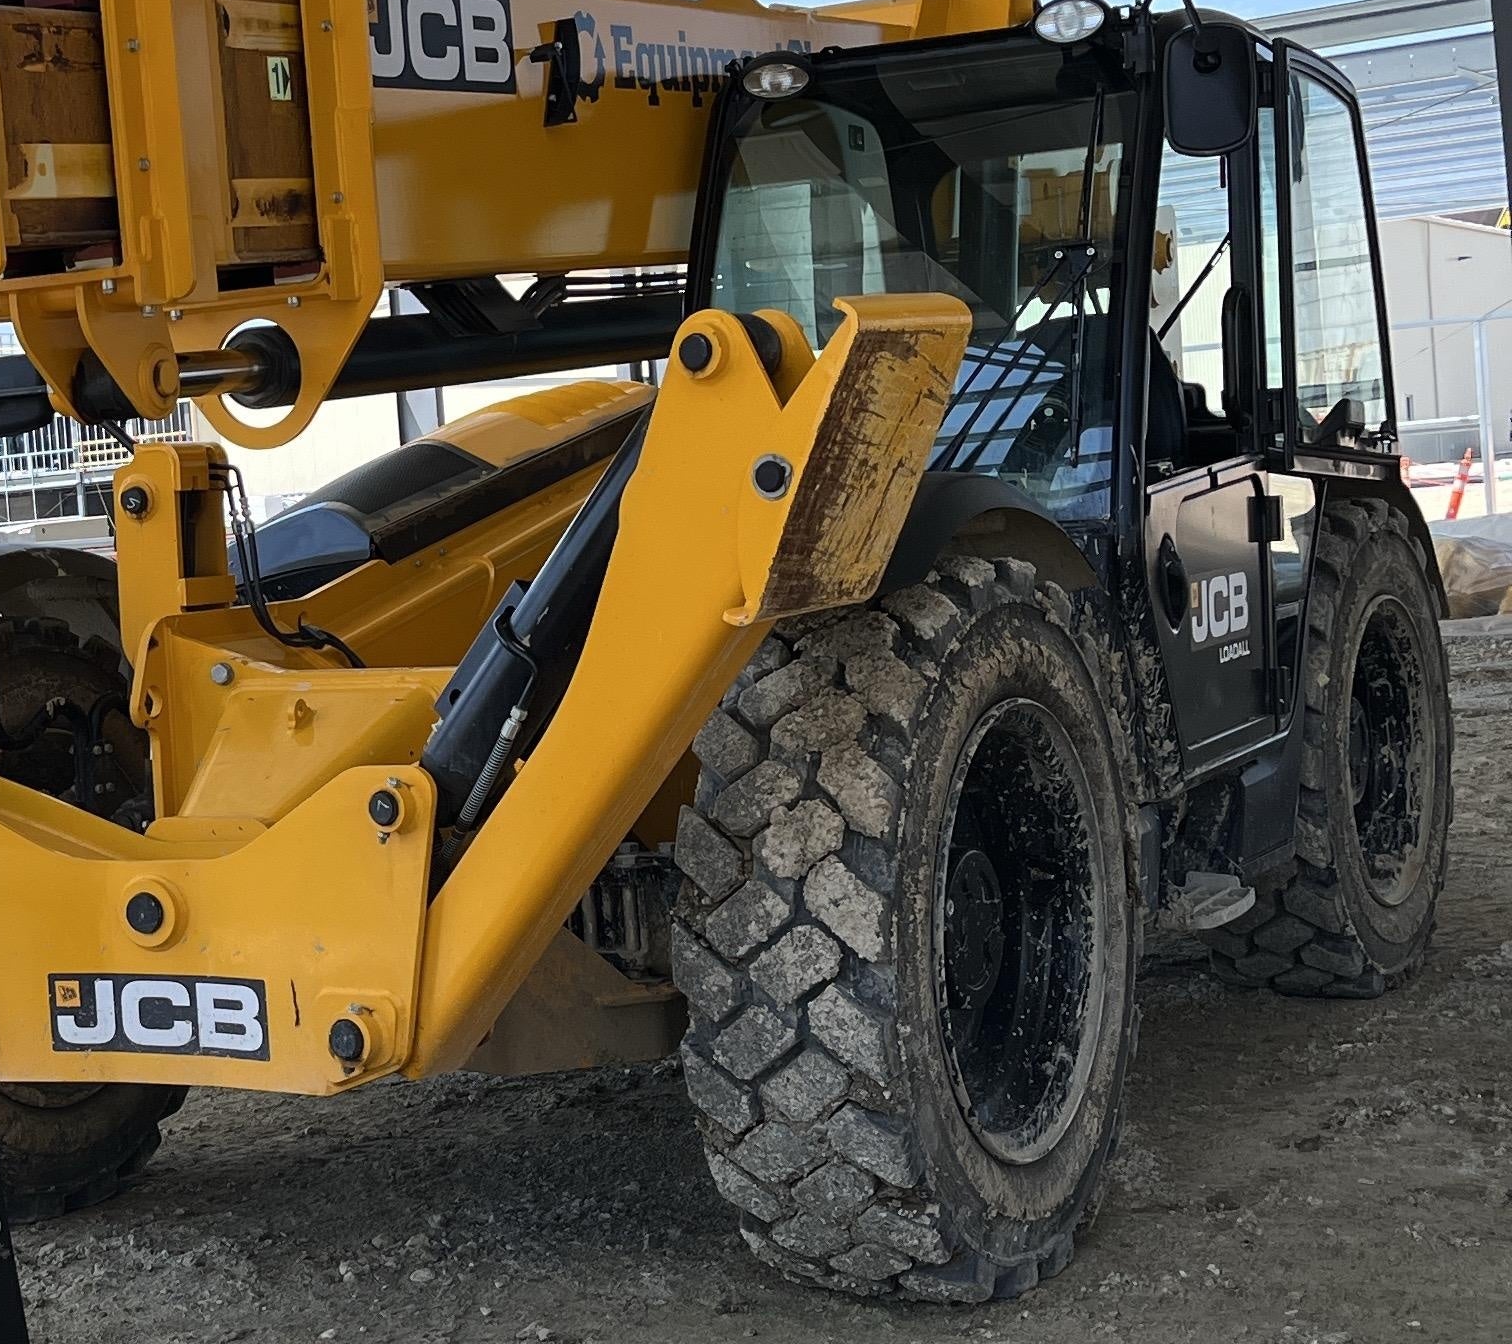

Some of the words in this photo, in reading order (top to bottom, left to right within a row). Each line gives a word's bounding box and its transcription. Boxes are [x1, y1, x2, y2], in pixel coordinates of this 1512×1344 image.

[1191, 571, 1249, 643] JCB
[1218, 639, 1251, 664] LOADALL
[56, 979, 264, 1052] JCB
